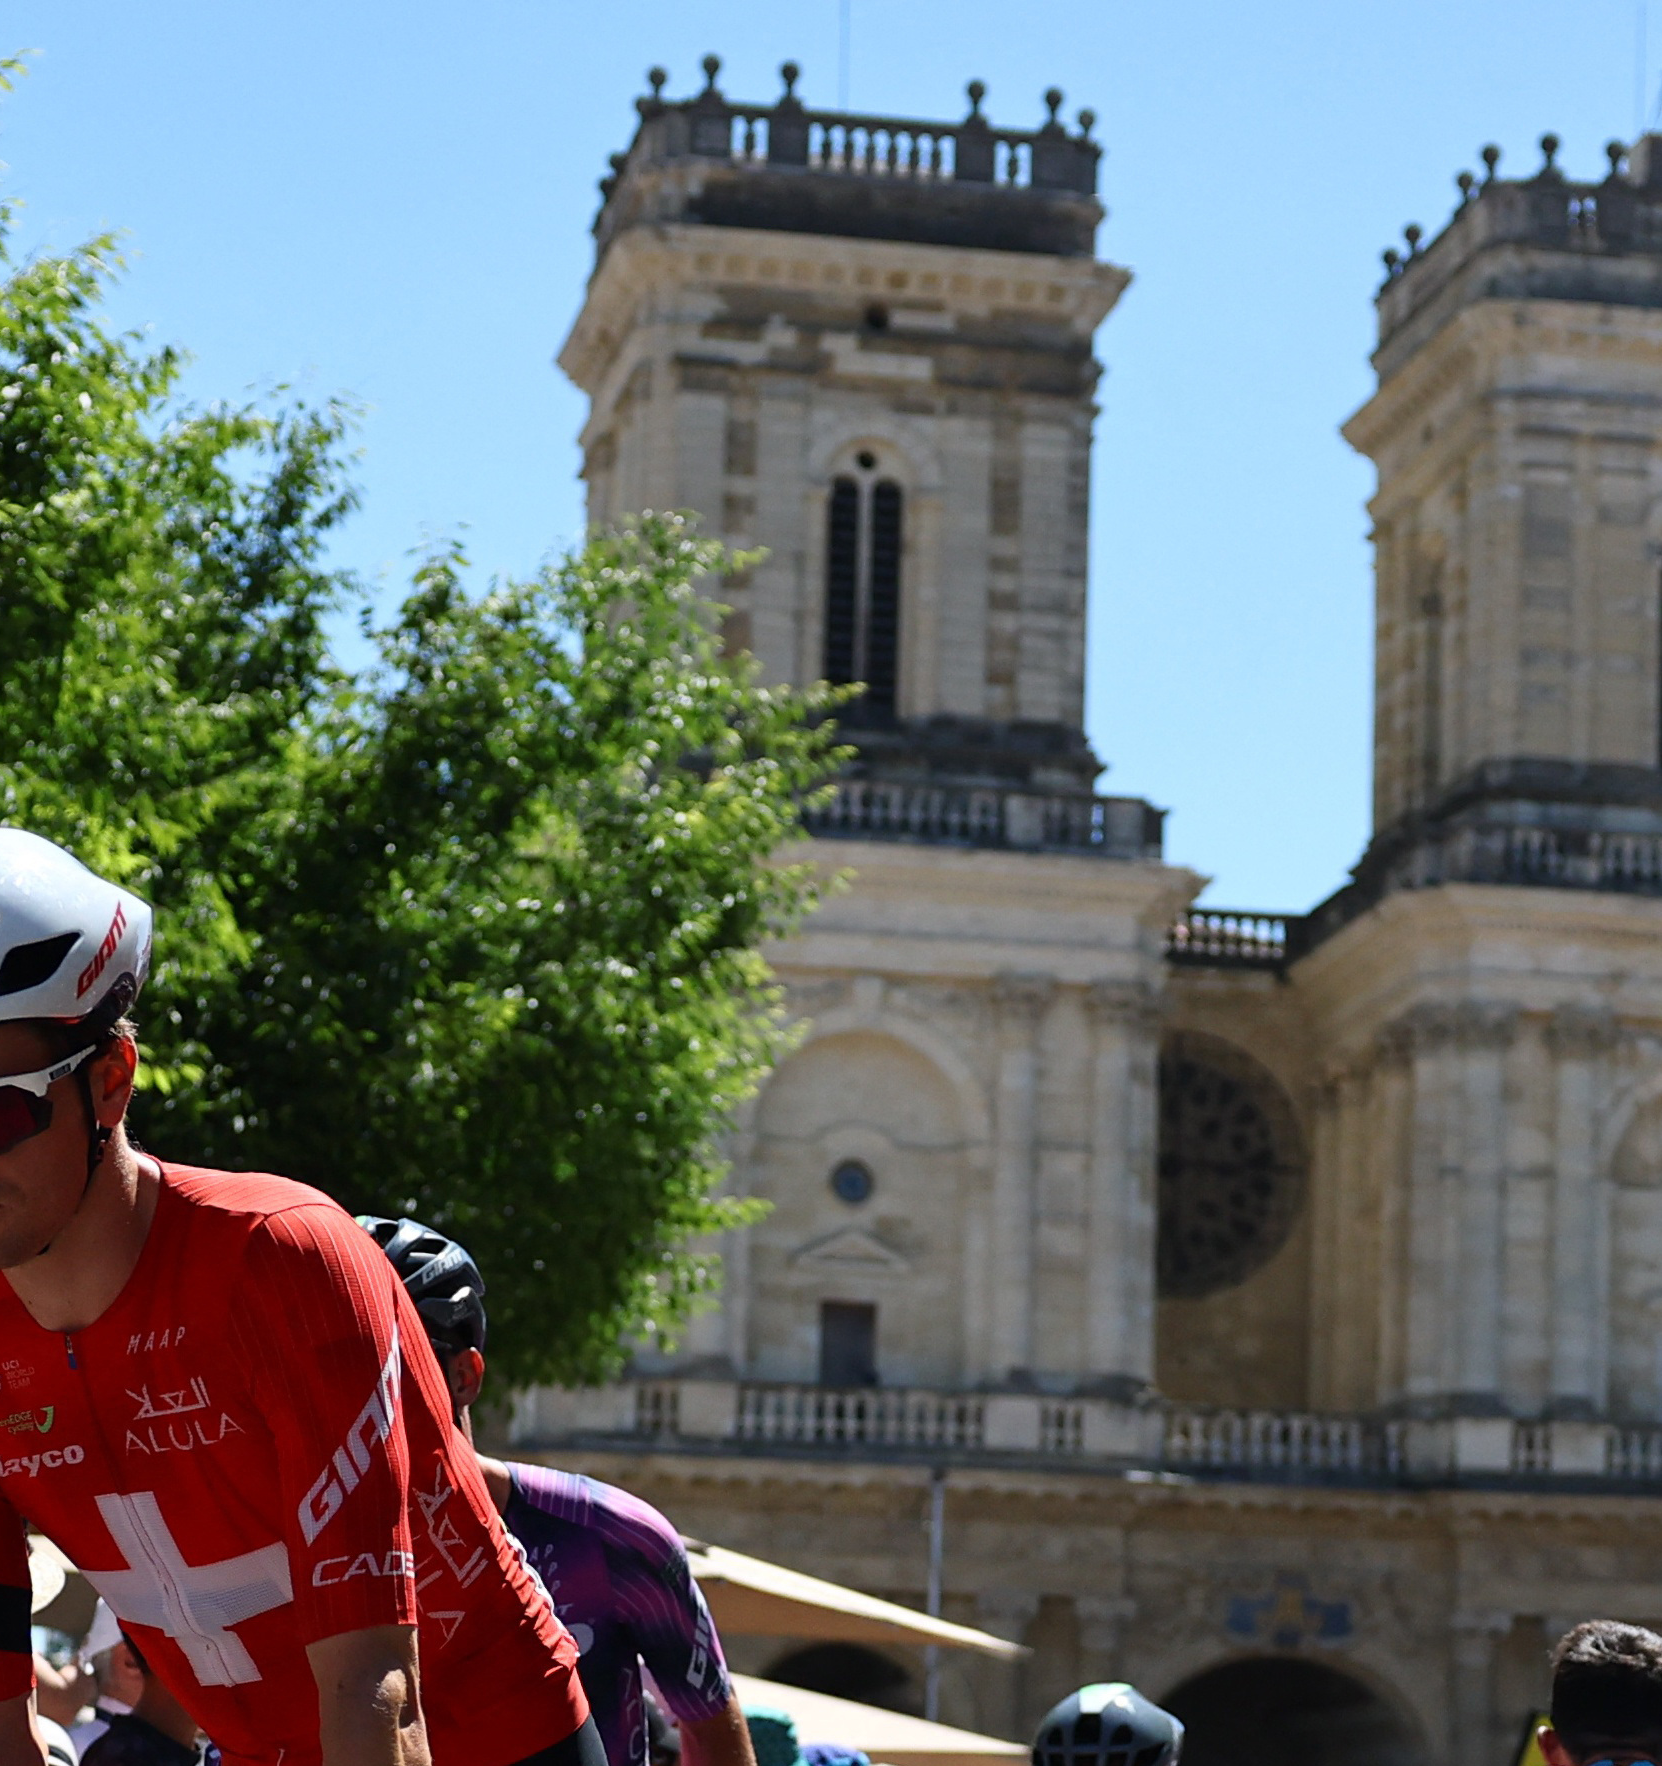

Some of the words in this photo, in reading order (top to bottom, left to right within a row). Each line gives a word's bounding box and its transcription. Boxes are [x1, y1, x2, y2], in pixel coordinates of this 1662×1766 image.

[77, 900, 128, 1000] GIANT
[421, 1249, 464, 1285] GIANT
[126, 1326, 186, 1355] MAAP
[125, 1412, 246, 1457] ALULA
